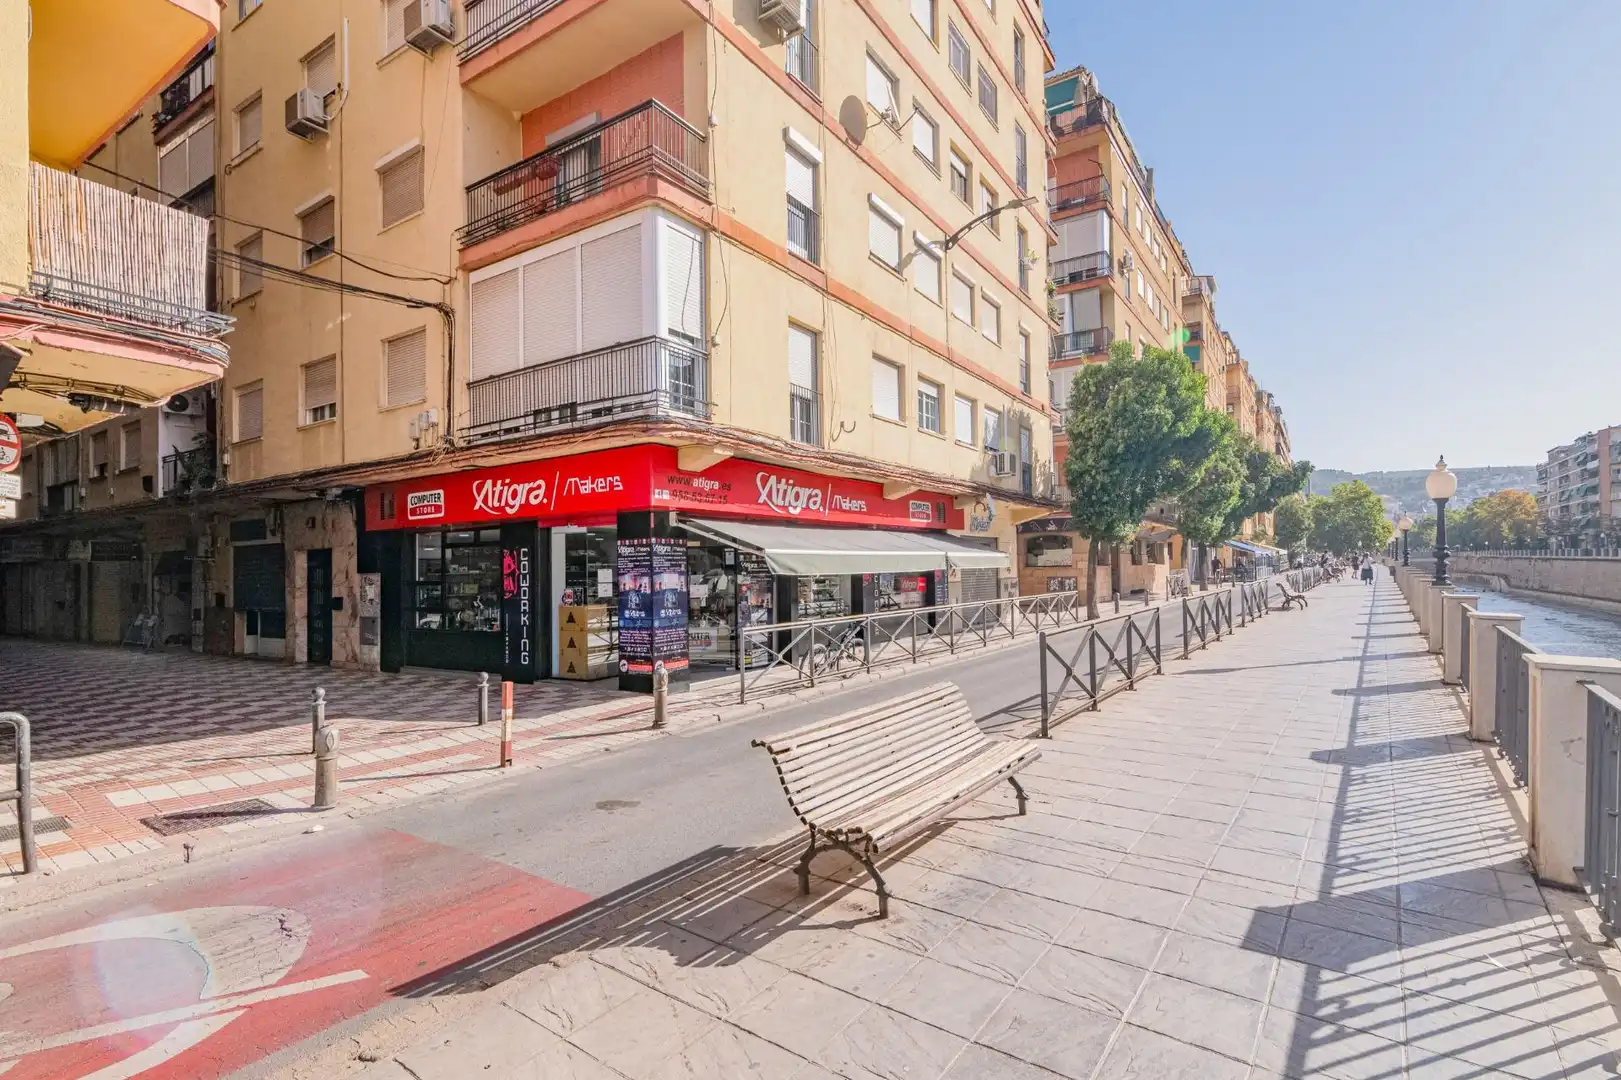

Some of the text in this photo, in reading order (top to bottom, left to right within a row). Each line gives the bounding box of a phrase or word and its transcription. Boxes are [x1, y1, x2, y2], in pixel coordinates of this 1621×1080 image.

[667, 475, 732, 492] www.atigra.es
[410, 492, 442, 506] COMPUTER
[416, 507, 435, 515] STORE
[519, 548, 530, 665] COWORKING
